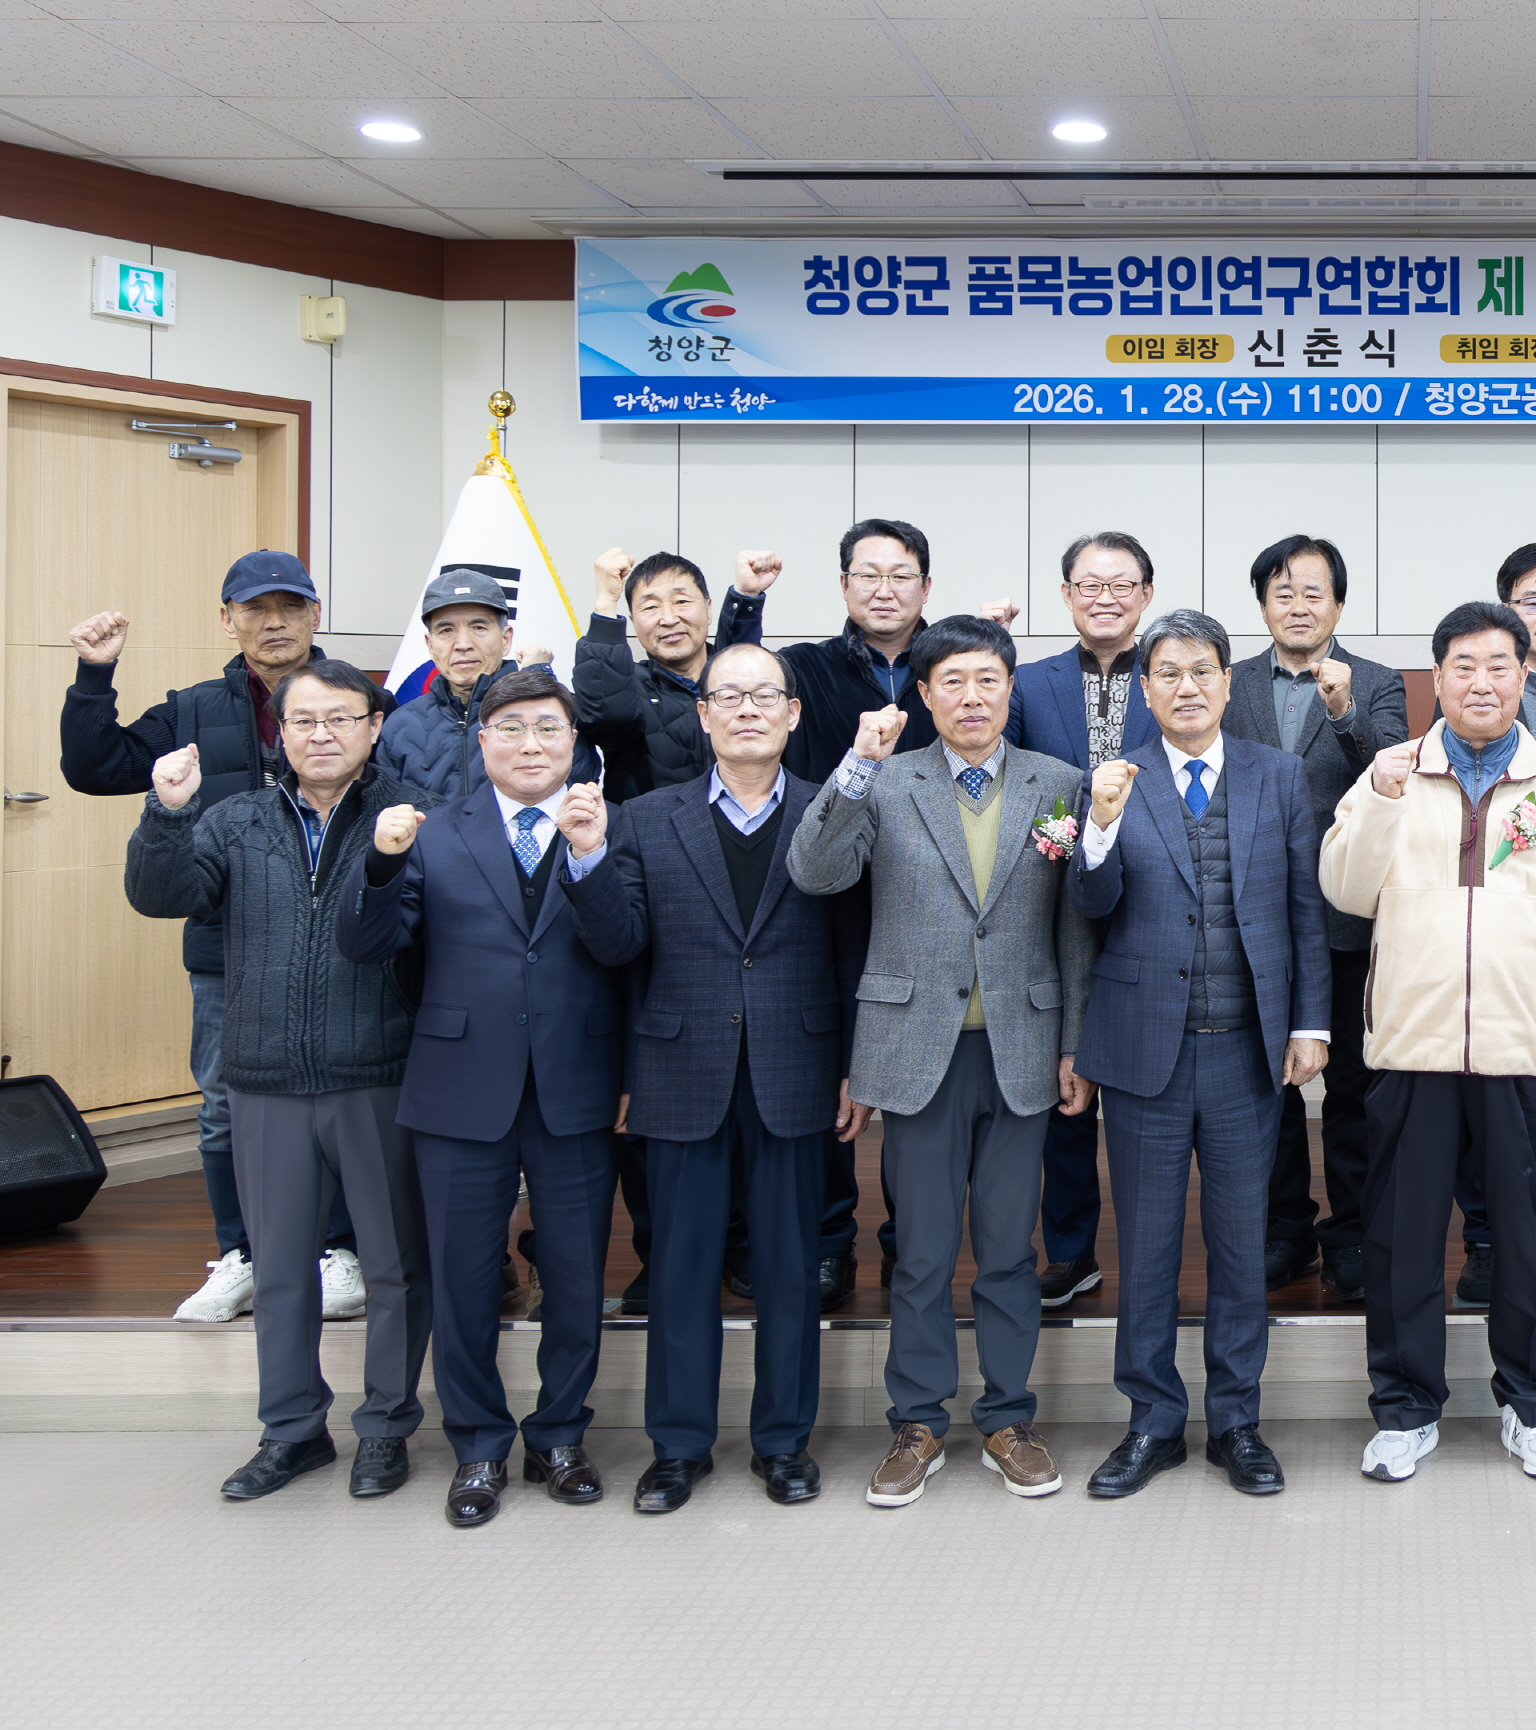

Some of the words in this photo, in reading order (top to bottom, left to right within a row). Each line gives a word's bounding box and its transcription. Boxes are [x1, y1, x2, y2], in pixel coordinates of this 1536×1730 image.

[803, 255, 951, 316] 청양군
[967, 255, 1461, 316] 품목농업인연구연합회
[1477, 255, 1524, 316] 제
[648, 335, 735, 362] 청양군
[1122, 336, 1165, 362] 이임
[1174, 336, 1220, 362] 회장
[1455, 336, 1500, 361] 취임
[613, 385, 679, 413] 다함께
[683, 391, 725, 410] 만드는
[729, 387, 776, 414] 청양
[1013, 384, 1103, 414] 2026.
[1121, 384, 1148, 414] 1.
[1288, 384, 1382, 413] 11:00
